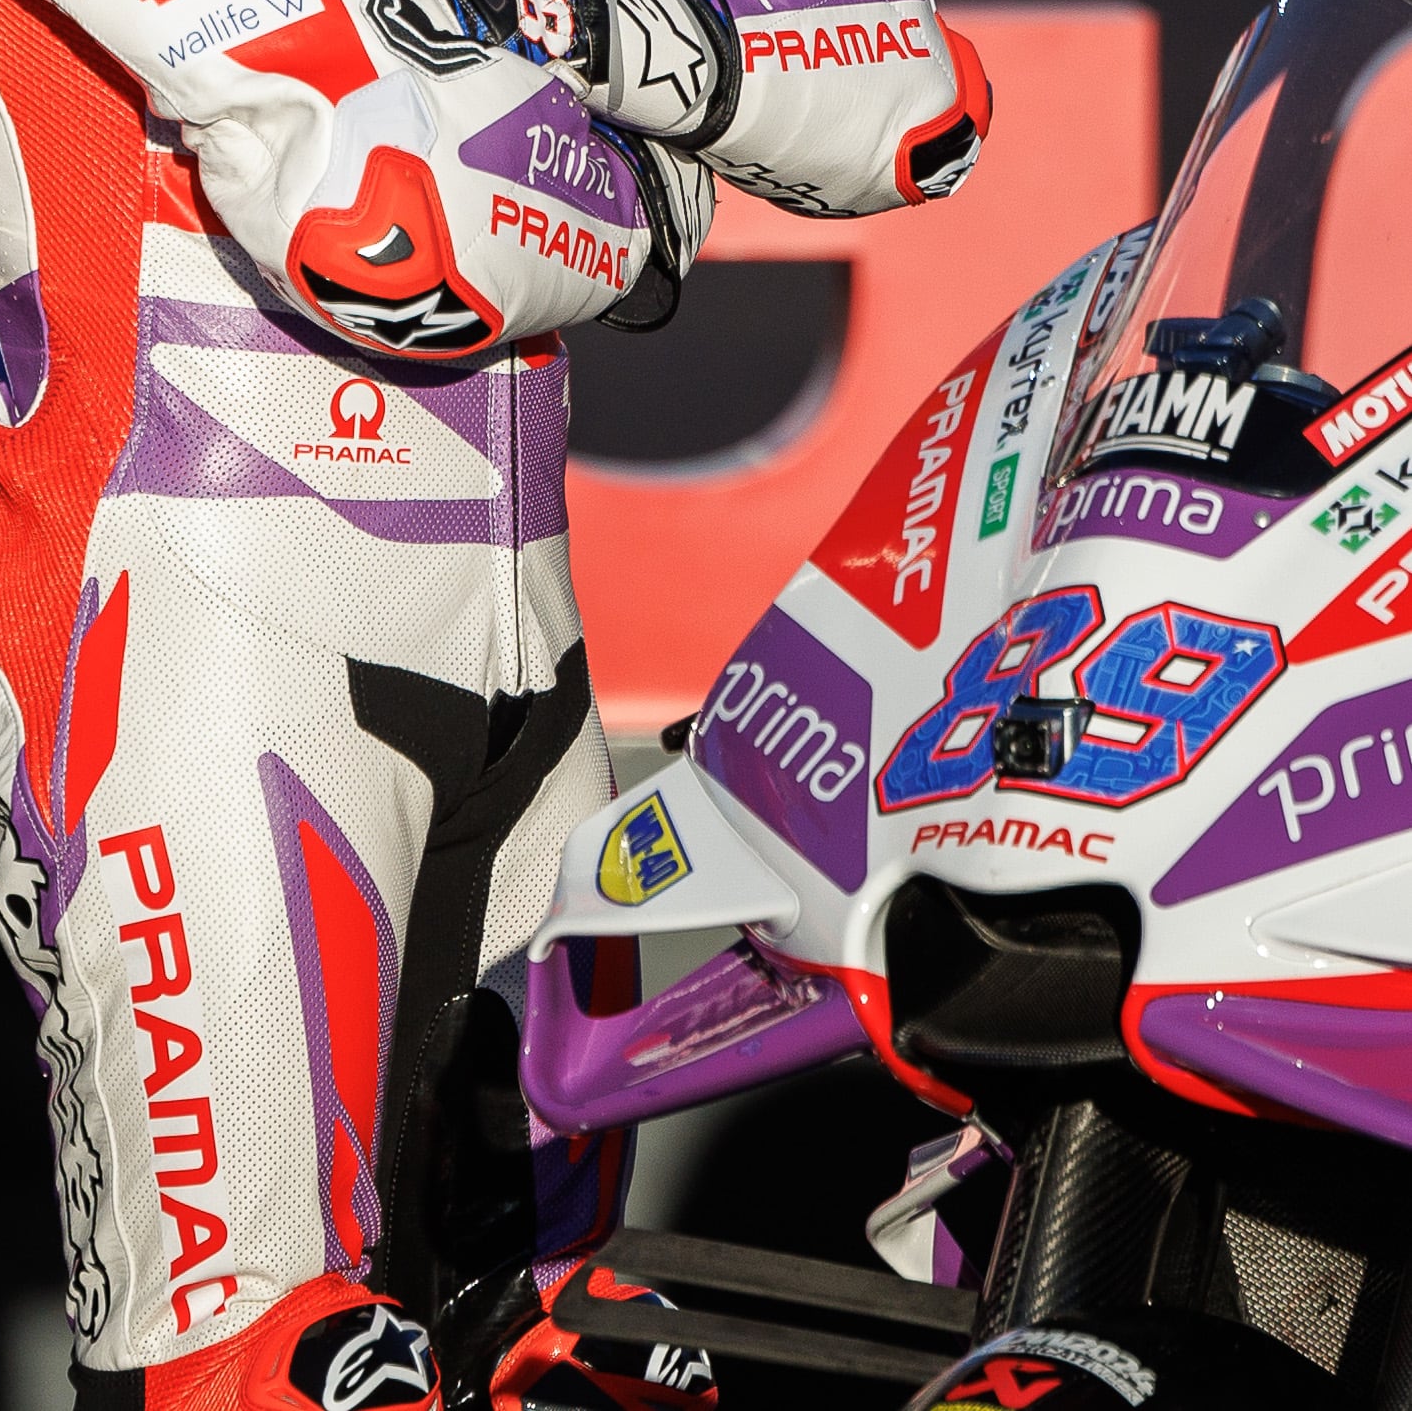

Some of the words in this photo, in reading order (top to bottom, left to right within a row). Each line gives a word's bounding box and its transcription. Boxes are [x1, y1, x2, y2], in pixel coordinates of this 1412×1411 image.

[159, 4, 260, 69] wallife
[744, 17, 930, 74] PRAMAC
[490, 193, 629, 290] PRAMAC
[1095, 370, 1258, 450] FIAMM
[294, 443, 412, 465] PRAMAC
[892, 370, 977, 606] PRAMAC
[985, 463, 1013, 526] SPORT
[1047, 470, 1226, 550] prima
[700, 660, 867, 803] prima
[874, 584, 1289, 814] 89
[911, 818, 1116, 865] PRAMAC
[97, 824, 238, 1336] PRAMAC
